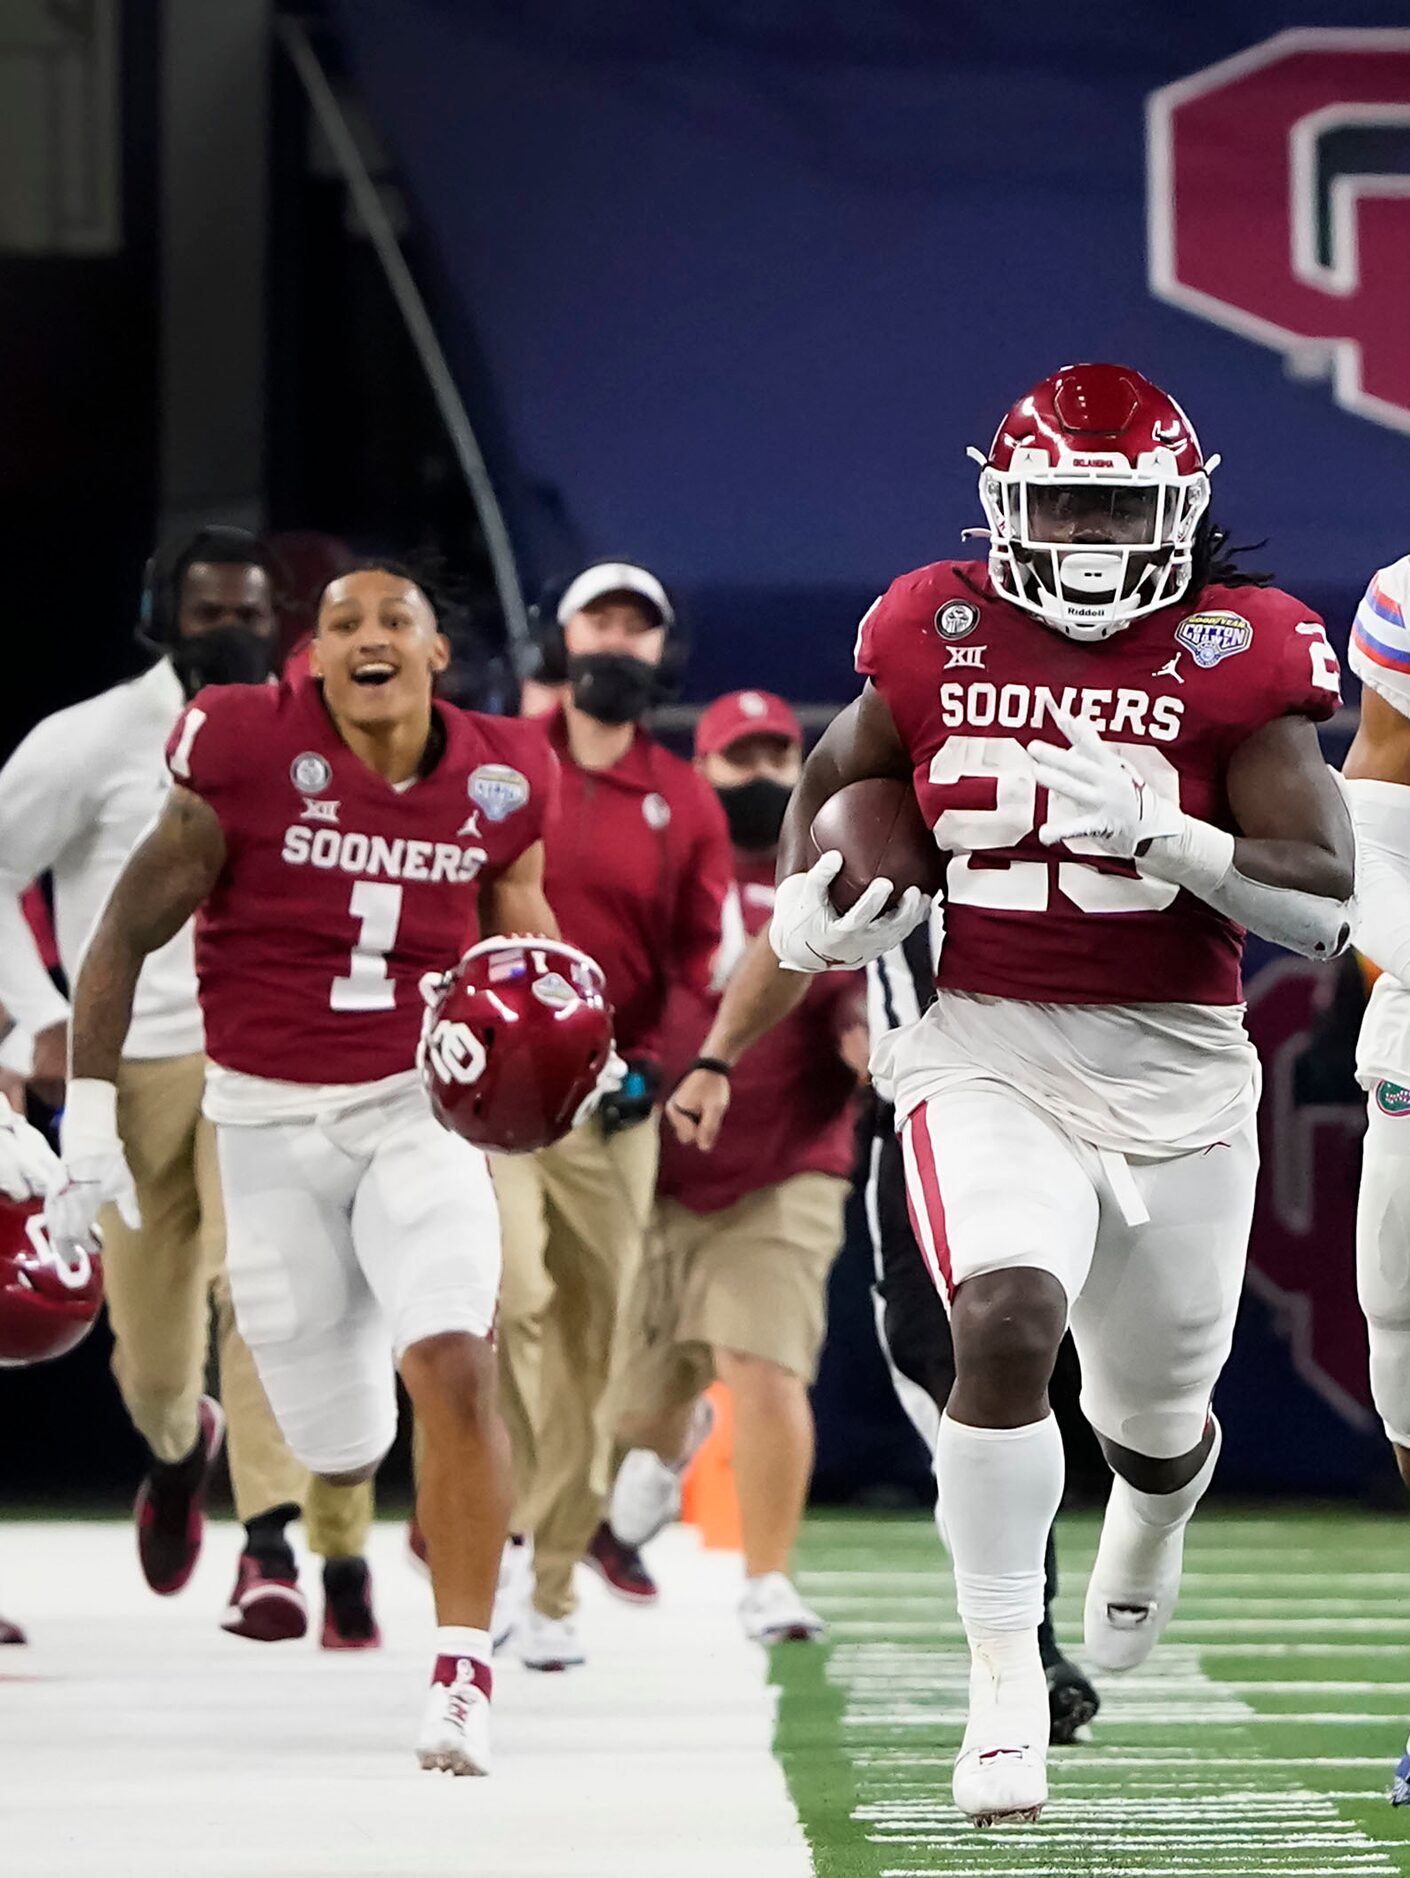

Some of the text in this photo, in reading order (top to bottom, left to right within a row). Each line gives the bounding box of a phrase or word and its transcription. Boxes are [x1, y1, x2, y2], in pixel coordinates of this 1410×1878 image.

[943, 645, 987, 669] XII
[1182, 623, 1246, 646] COTTON
[940, 682, 1184, 742] SOONERS
[170, 707, 207, 778] 1
[281, 824, 489, 883] SOONERS
[329, 880, 402, 1011] 1
